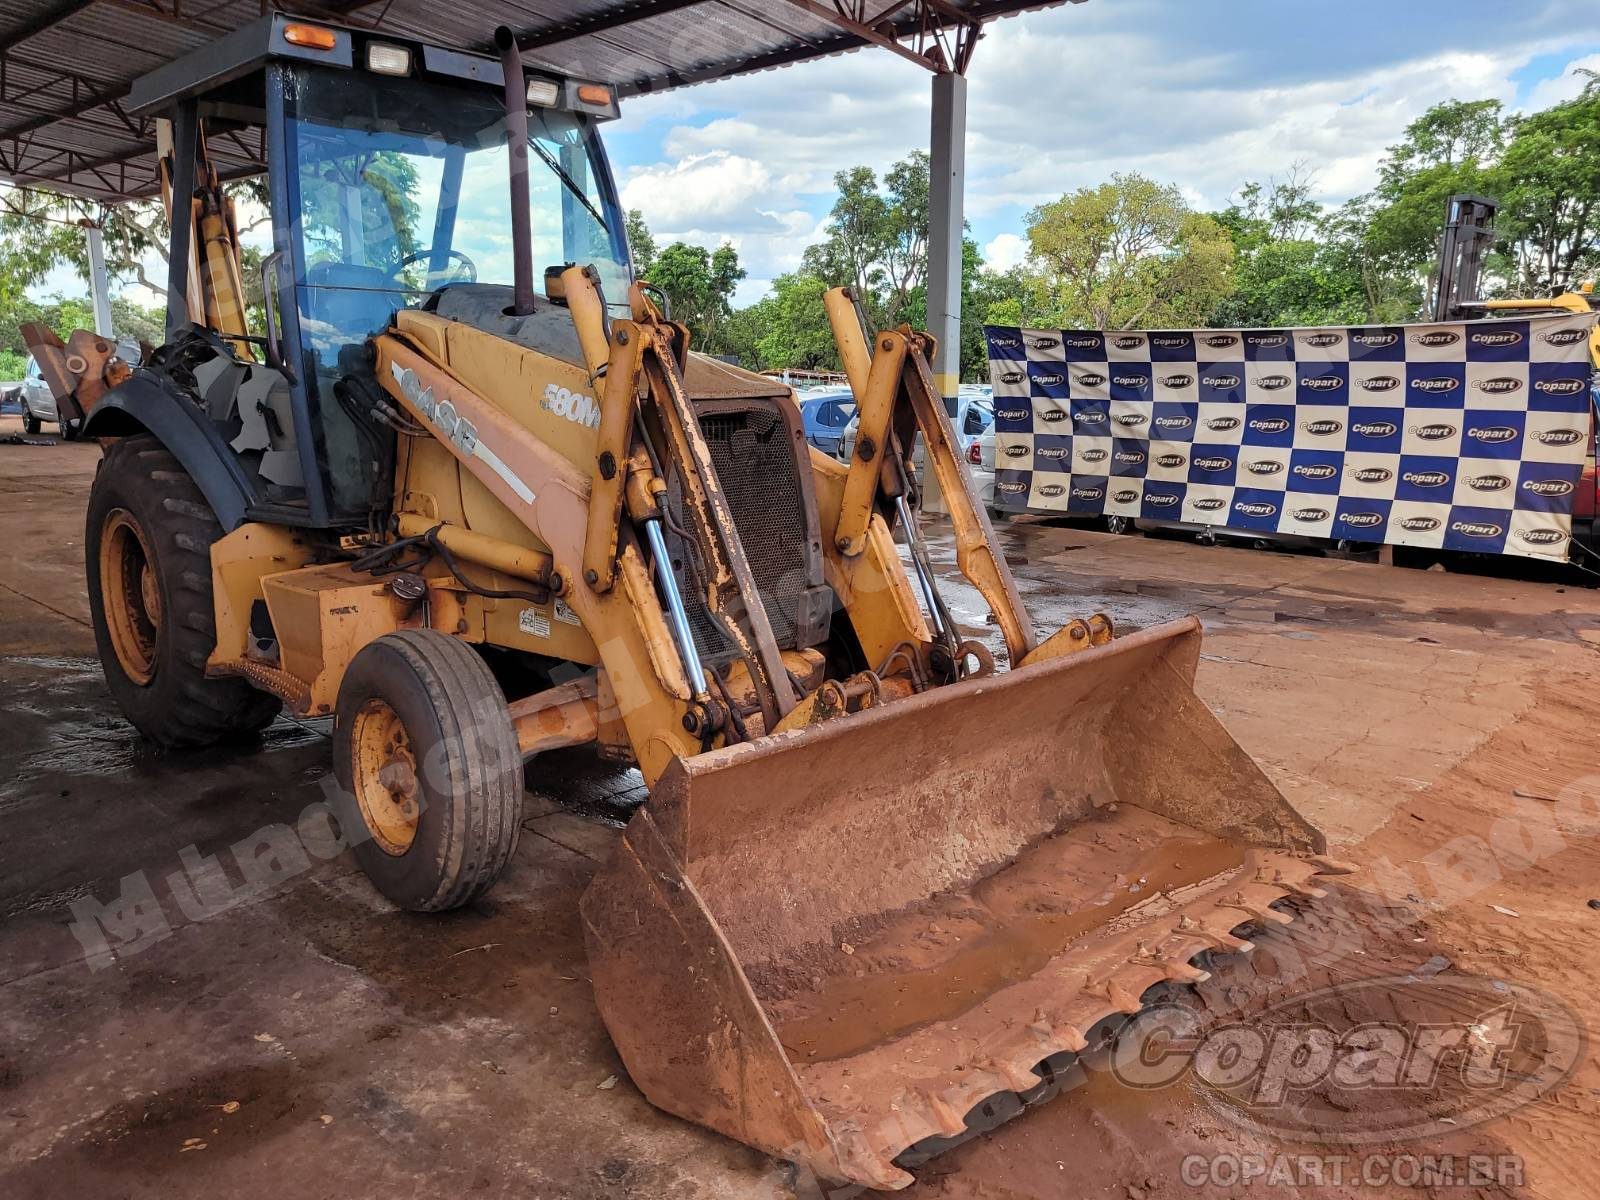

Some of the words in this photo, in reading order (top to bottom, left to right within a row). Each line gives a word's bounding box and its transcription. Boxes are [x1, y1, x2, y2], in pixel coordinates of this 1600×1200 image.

[1067, 338, 1098, 348] Copart
[1154, 337, 1186, 346] Copart
[1248, 334, 1284, 344] Copart
[1353, 333, 1394, 344] Copart
[1472, 332, 1519, 344] Copart
[1032, 374, 1060, 384] Copart
[1114, 376, 1145, 386] Copart
[1202, 376, 1236, 386] Copart
[1301, 376, 1340, 388] Copart
[1412, 378, 1455, 389] Copart
[1534, 380, 1581, 391] Copart
[998, 410, 1025, 418] Copart
[1074, 412, 1103, 422] Copart
[1156, 416, 1189, 427] Copart
[1250, 418, 1286, 431] Copart
[1352, 423, 1393, 434] Copart
[1468, 428, 1514, 440] Copart
[1038, 448, 1066, 458] Copart
[1115, 451, 1142, 462] Copart
[1194, 457, 1228, 469] Copart
[1294, 465, 1333, 476] Copart
[1402, 472, 1446, 484] Copart
[998, 482, 1024, 490] Copart
[1522, 480, 1570, 492] Copart
[1072, 488, 1100, 498] Copart
[1145, 494, 1176, 504] Copart
[1235, 502, 1273, 514] Copart
[1339, 513, 1380, 524] Copart
[1452, 522, 1499, 534] Copart
